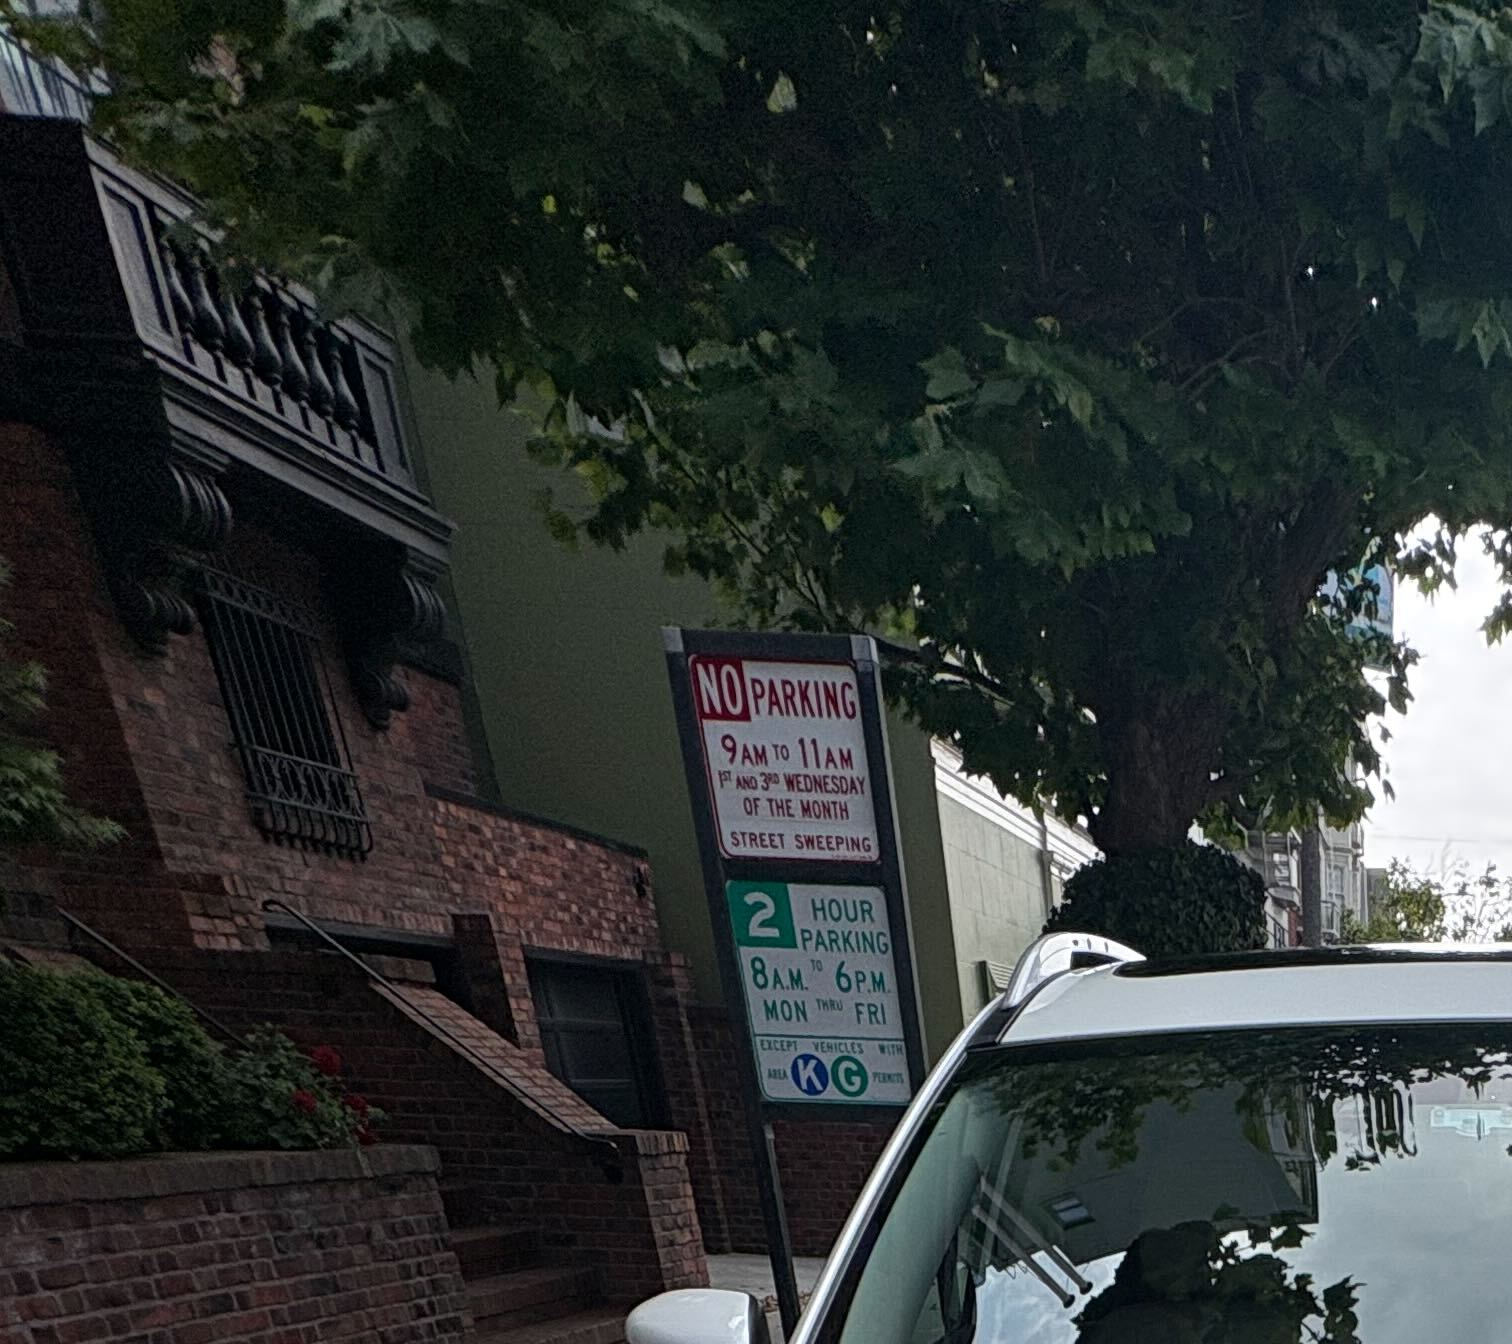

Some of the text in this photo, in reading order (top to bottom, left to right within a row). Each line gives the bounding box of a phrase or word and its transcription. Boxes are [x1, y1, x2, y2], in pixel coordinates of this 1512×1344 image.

[696, 663, 857, 720] NO PARKING
[772, 744, 790, 761] TO
[736, 776, 758, 791] AND
[784, 773, 866, 796] WEDNESDAY
[743, 797, 850, 821] OF THE MONTH
[730, 831, 872, 853] STREET SWEEPING
[743, 891, 780, 938] 2
[811, 897, 876, 923] HOUR
[800, 928, 890, 955] PARKING
[811, 959, 824, 973] TO
[763, 997, 888, 1025] MON THRU FRI
[760, 1039, 905, 1057] EXCEPT VEHICLES WITH
[767, 1068, 789, 1081] AREA
[797, 1058, 825, 1092] K
[837, 1060, 862, 1093] G
